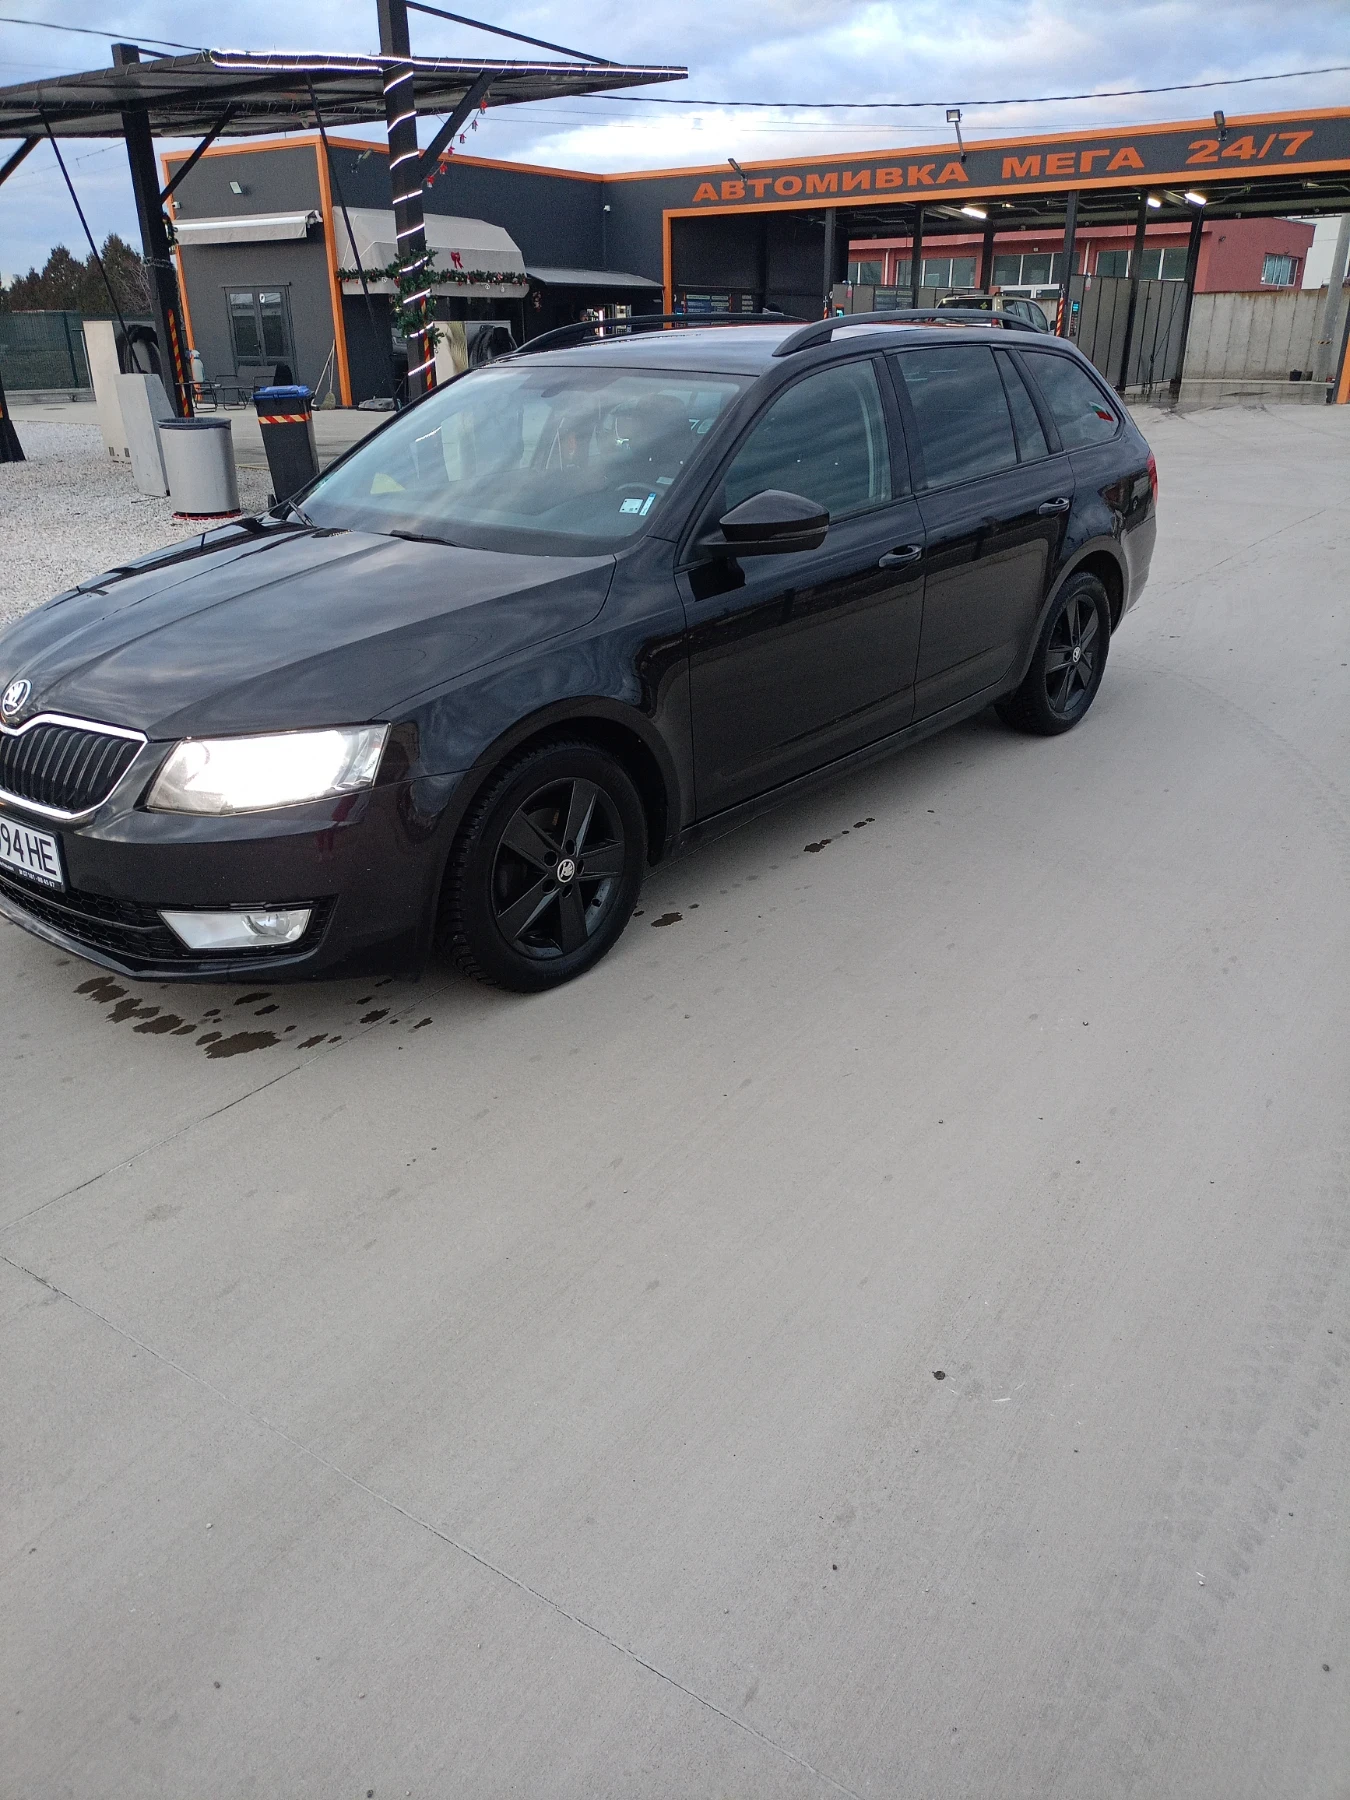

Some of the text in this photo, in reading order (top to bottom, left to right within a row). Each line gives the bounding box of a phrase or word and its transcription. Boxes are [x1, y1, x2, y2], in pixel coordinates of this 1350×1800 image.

[693, 130, 1314, 201] АВТОМИВКА МЕГА 24/7
[0, 823, 57, 876] 94HE
